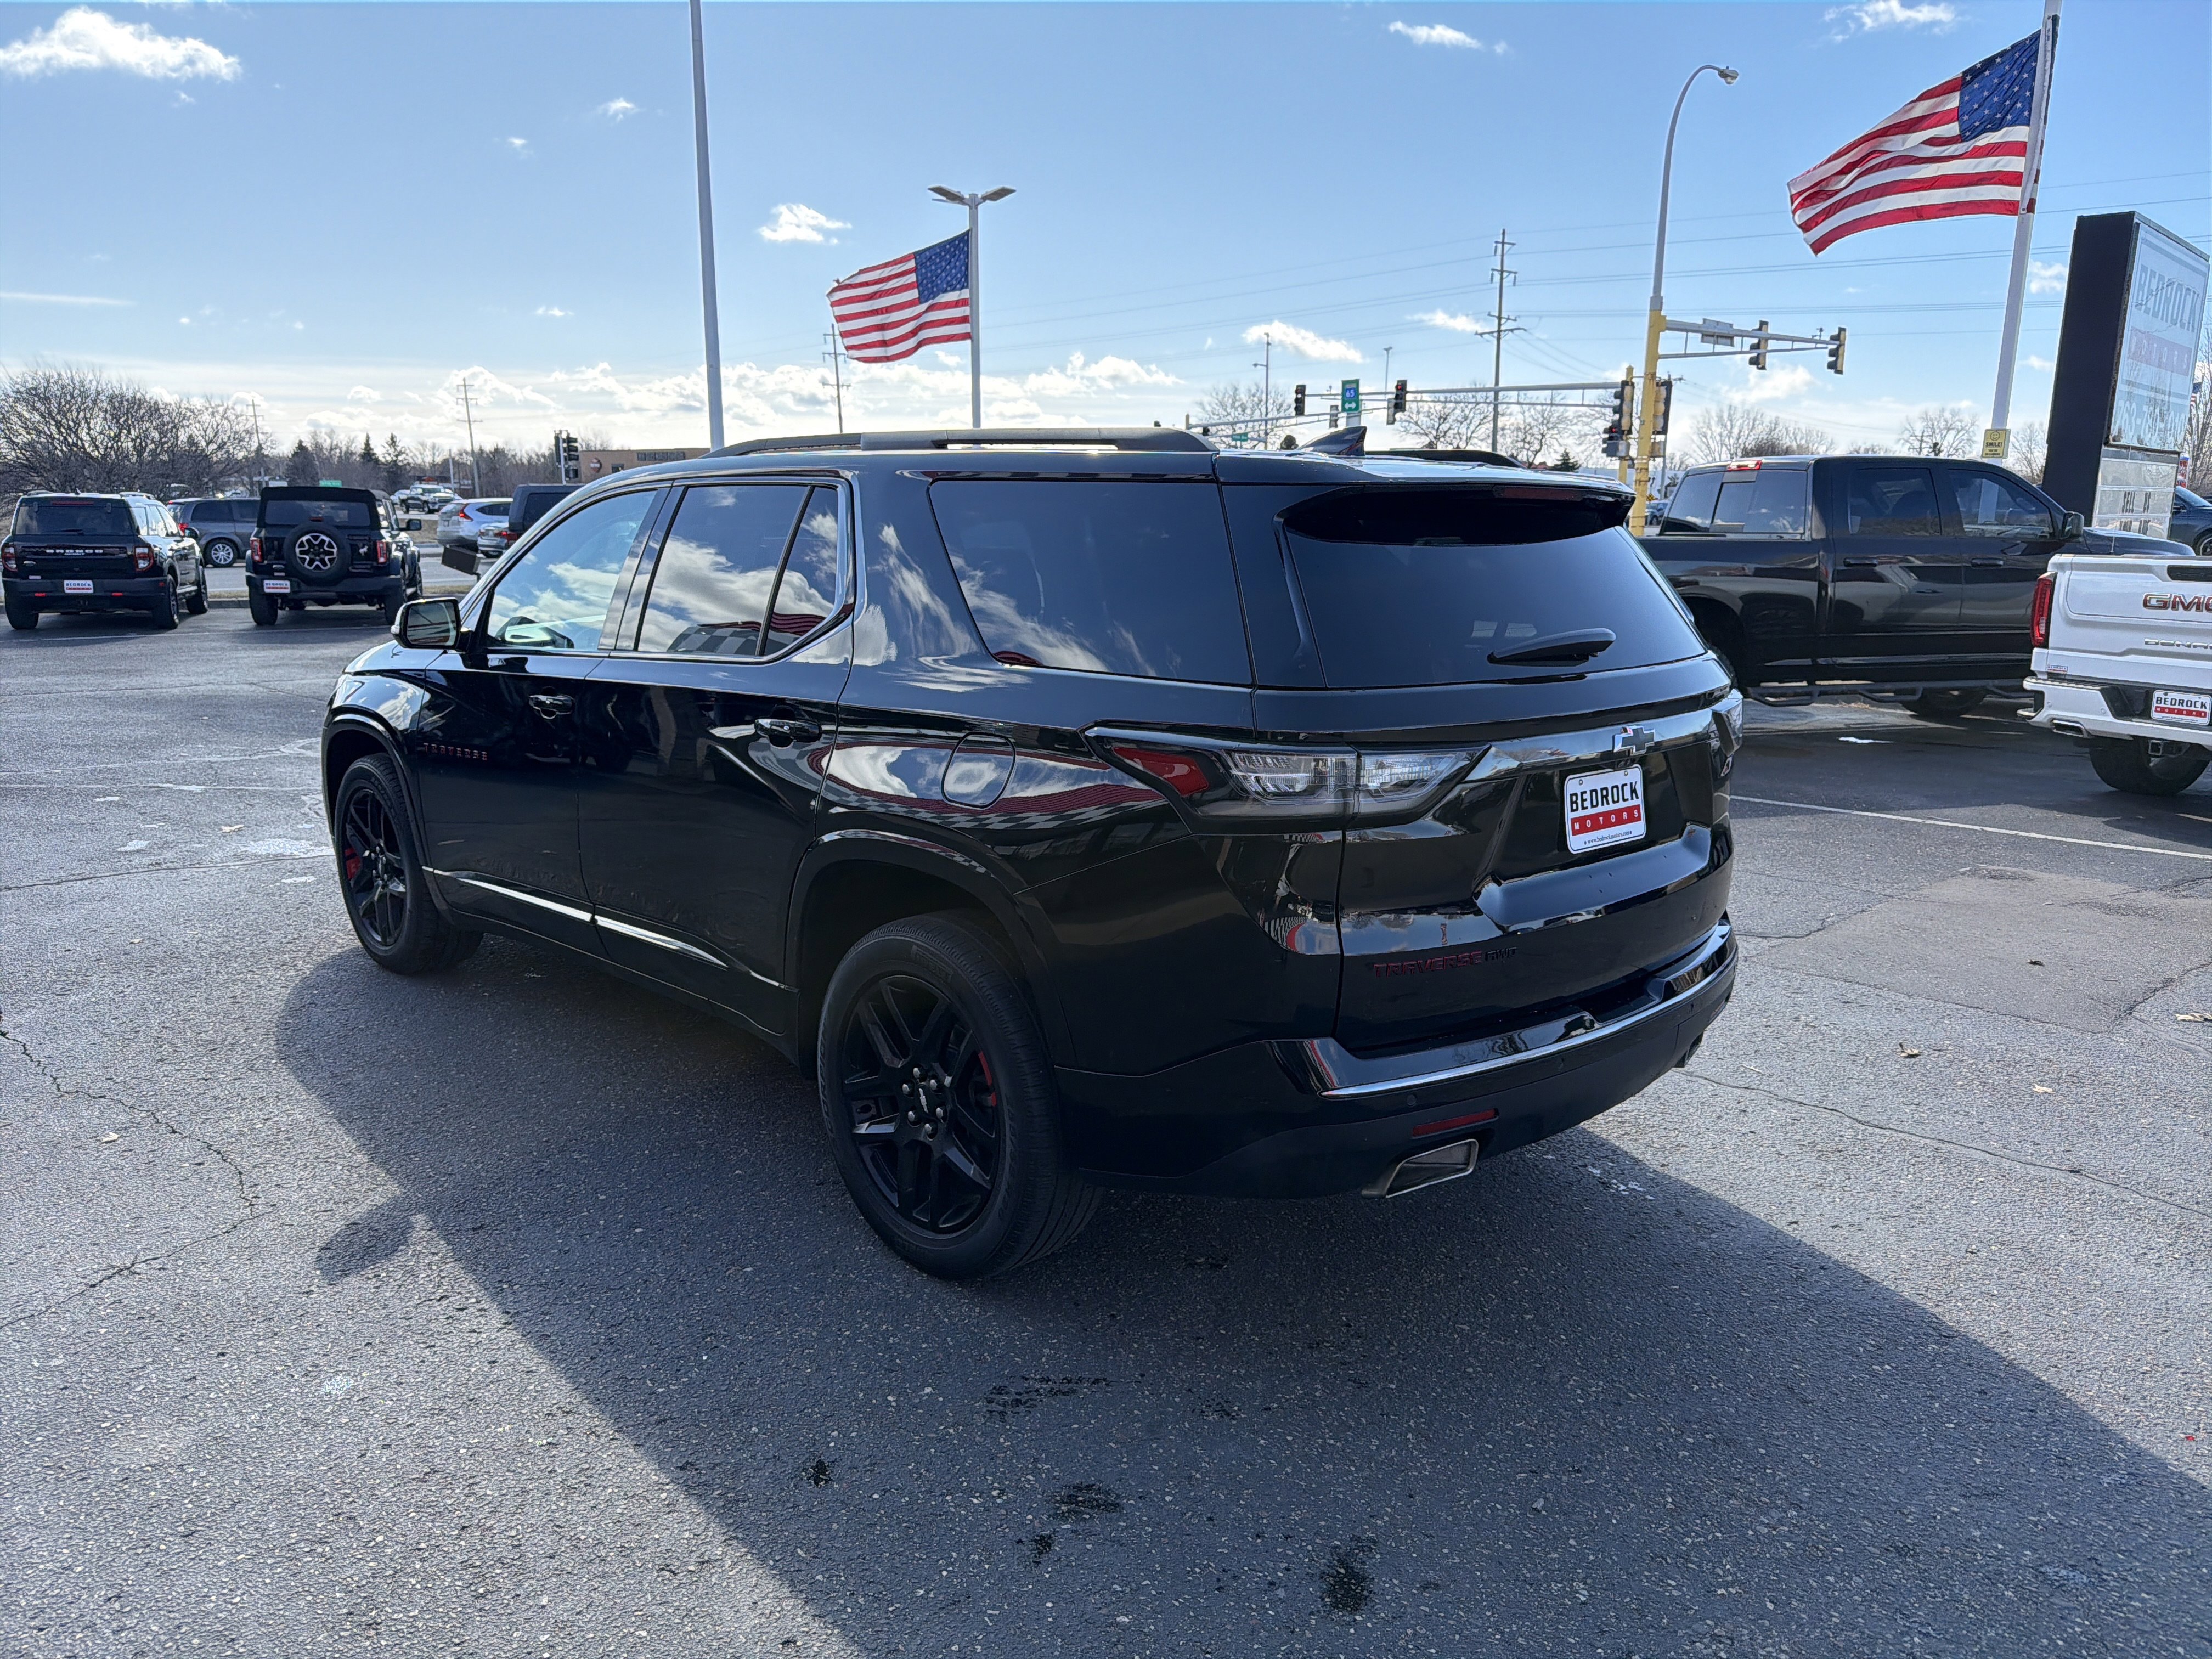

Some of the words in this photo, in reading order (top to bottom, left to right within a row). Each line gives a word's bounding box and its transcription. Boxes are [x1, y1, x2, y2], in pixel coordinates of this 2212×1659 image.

[2135, 264, 2200, 332] BEDROCK
[2131, 336, 2188, 369] MOTORS
[2142, 592, 2212, 613] GM
[2155, 697, 2208, 709] BEDROCK
[2157, 708, 2205, 716] MOTORS
[1570, 781, 1640, 812] BEDROCK
[1574, 809, 1639, 830] MOTORS
[1587, 831, 1629, 844] www.bedrockmotors.com
[1373, 950, 1482, 978] TRAVERSE
